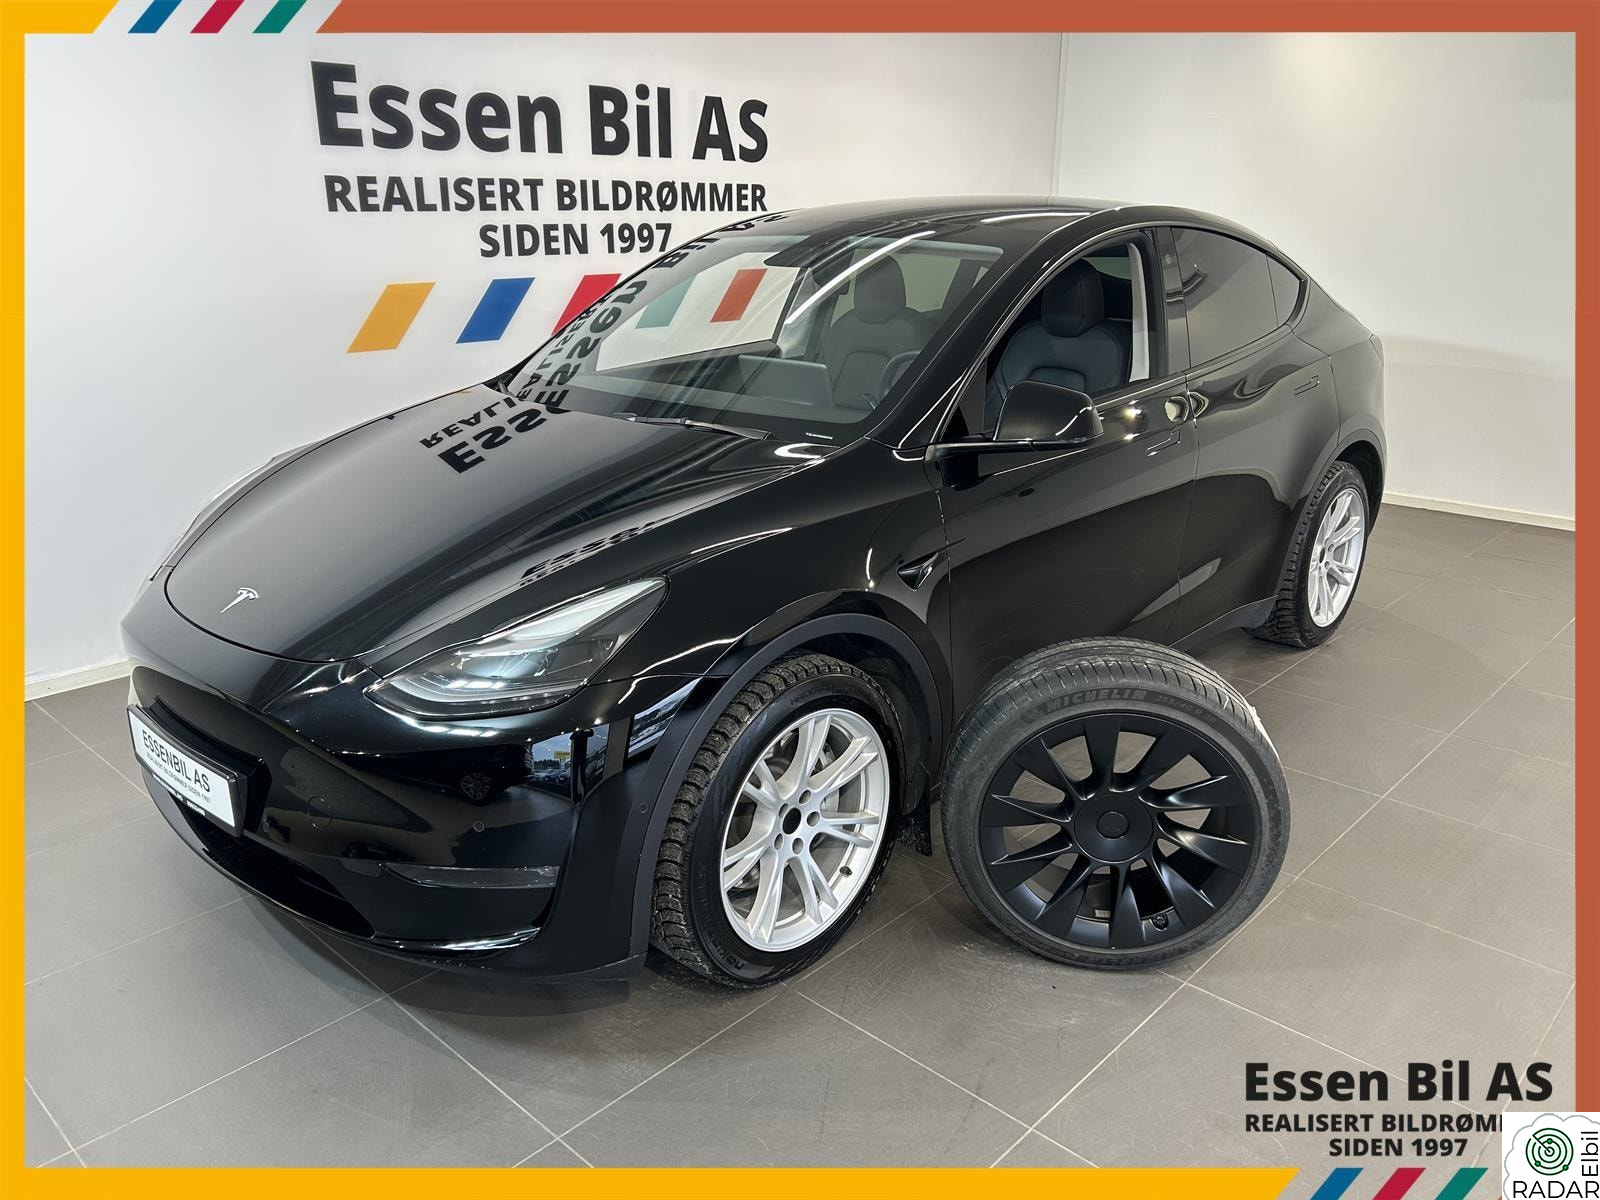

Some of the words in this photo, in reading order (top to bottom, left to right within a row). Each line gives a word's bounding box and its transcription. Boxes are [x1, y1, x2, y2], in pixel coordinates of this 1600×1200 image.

[310, 60, 563, 154] Essen
[588, 83, 672, 159] Bil
[692, 95, 768, 163] AS
[324, 174, 544, 212] REALISERT
[556, 178, 768, 213] BILDRØMMER
[479, 222, 589, 258] SIDEN
[599, 222, 672, 254] 1997
[1046, 688, 1149, 713] MICHELIN
[142, 729, 192, 782] ESSENBIL
[194, 768, 211, 793] AS
